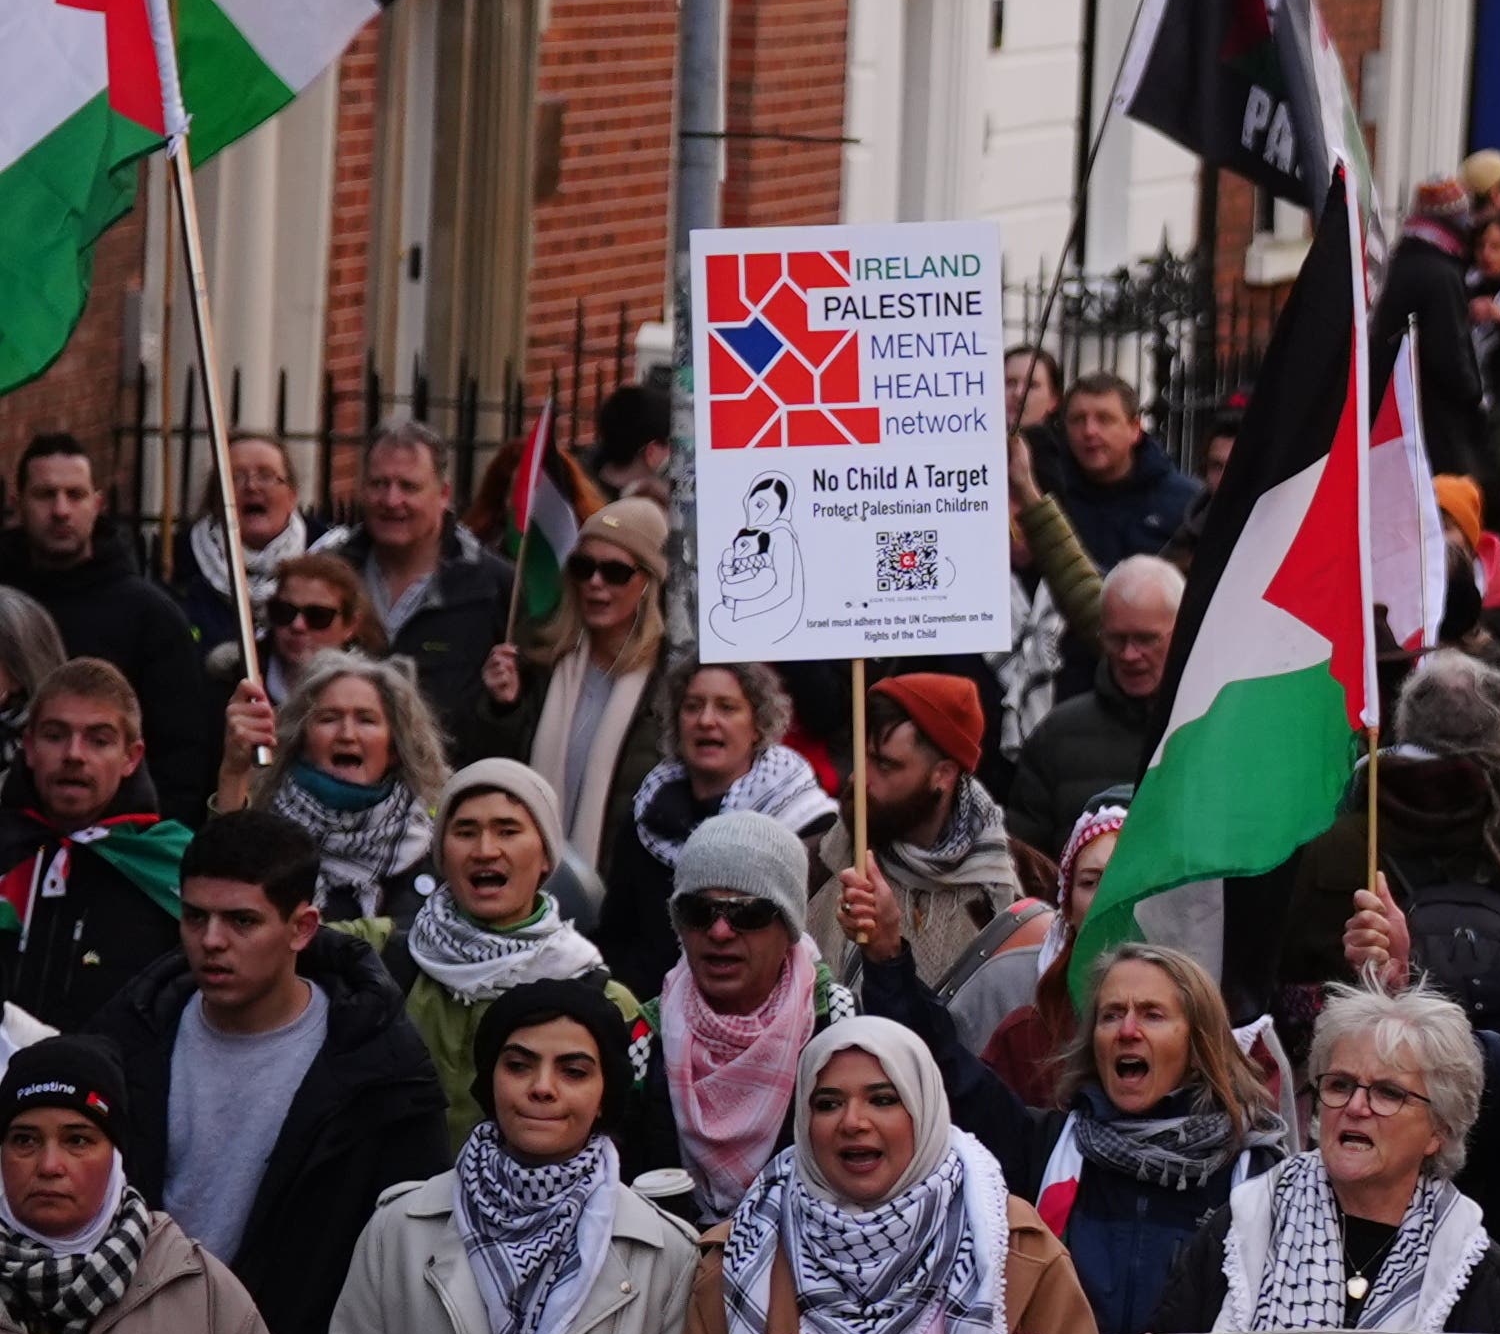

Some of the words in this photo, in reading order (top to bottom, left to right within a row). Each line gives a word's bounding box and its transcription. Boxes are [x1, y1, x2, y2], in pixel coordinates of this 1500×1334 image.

[855, 253, 982, 282] IRELAND
[823, 291, 983, 321] PALESTINE
[870, 331, 988, 361] MENTAL
[873, 371, 985, 400] HEALTH
[885, 407, 988, 436] network
[812, 468, 839, 492] No
[846, 466, 898, 491] Child
[904, 465, 918, 489] A
[924, 463, 988, 493] Target
[812, 502, 859, 518] Protect
[862, 499, 932, 517] Palestinian
[936, 497, 988, 514] Children
[806, 618, 830, 628] Israel
[831, 616, 852, 627] must
[854, 614, 882, 627] adhere
[884, 615, 892, 625] to
[894, 614, 907, 625] the
[909, 614, 920, 624] UN
[922, 612, 967, 624] Convention
[969, 613, 979, 622] on
[980, 611, 994, 621] the
[864, 630, 889, 643] Rights
[891, 630, 900, 640] of
[902, 630, 914, 639] the
[916, 629, 937, 639] Child
[17, 1081, 76, 1101] Palestine
